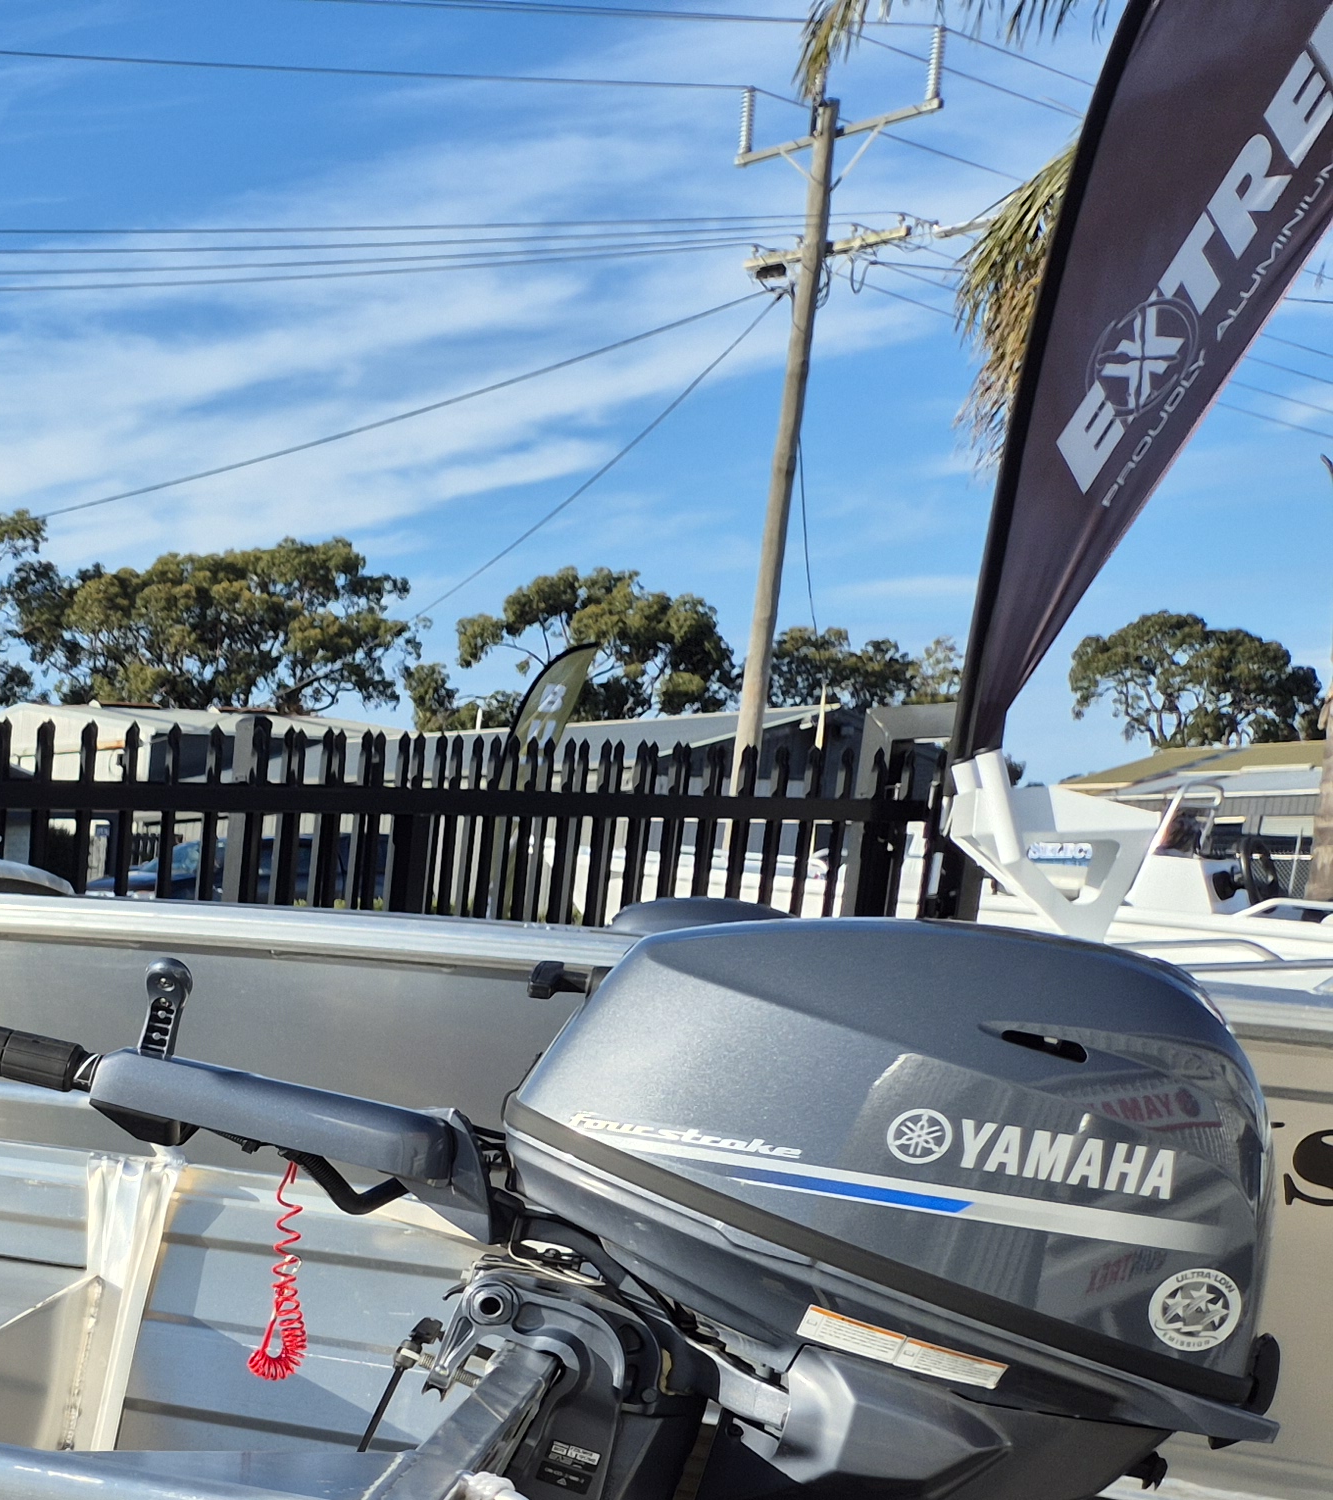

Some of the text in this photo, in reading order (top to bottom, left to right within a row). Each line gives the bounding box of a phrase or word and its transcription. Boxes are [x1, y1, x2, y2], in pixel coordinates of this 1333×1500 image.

[1056, 0, 1333, 495] EXTRE
[1102, 348, 1206, 507] PROUDLY
[960, 1120, 1177, 1200] YAMAHA
[1163, 1332, 1210, 1348] EMISSION
